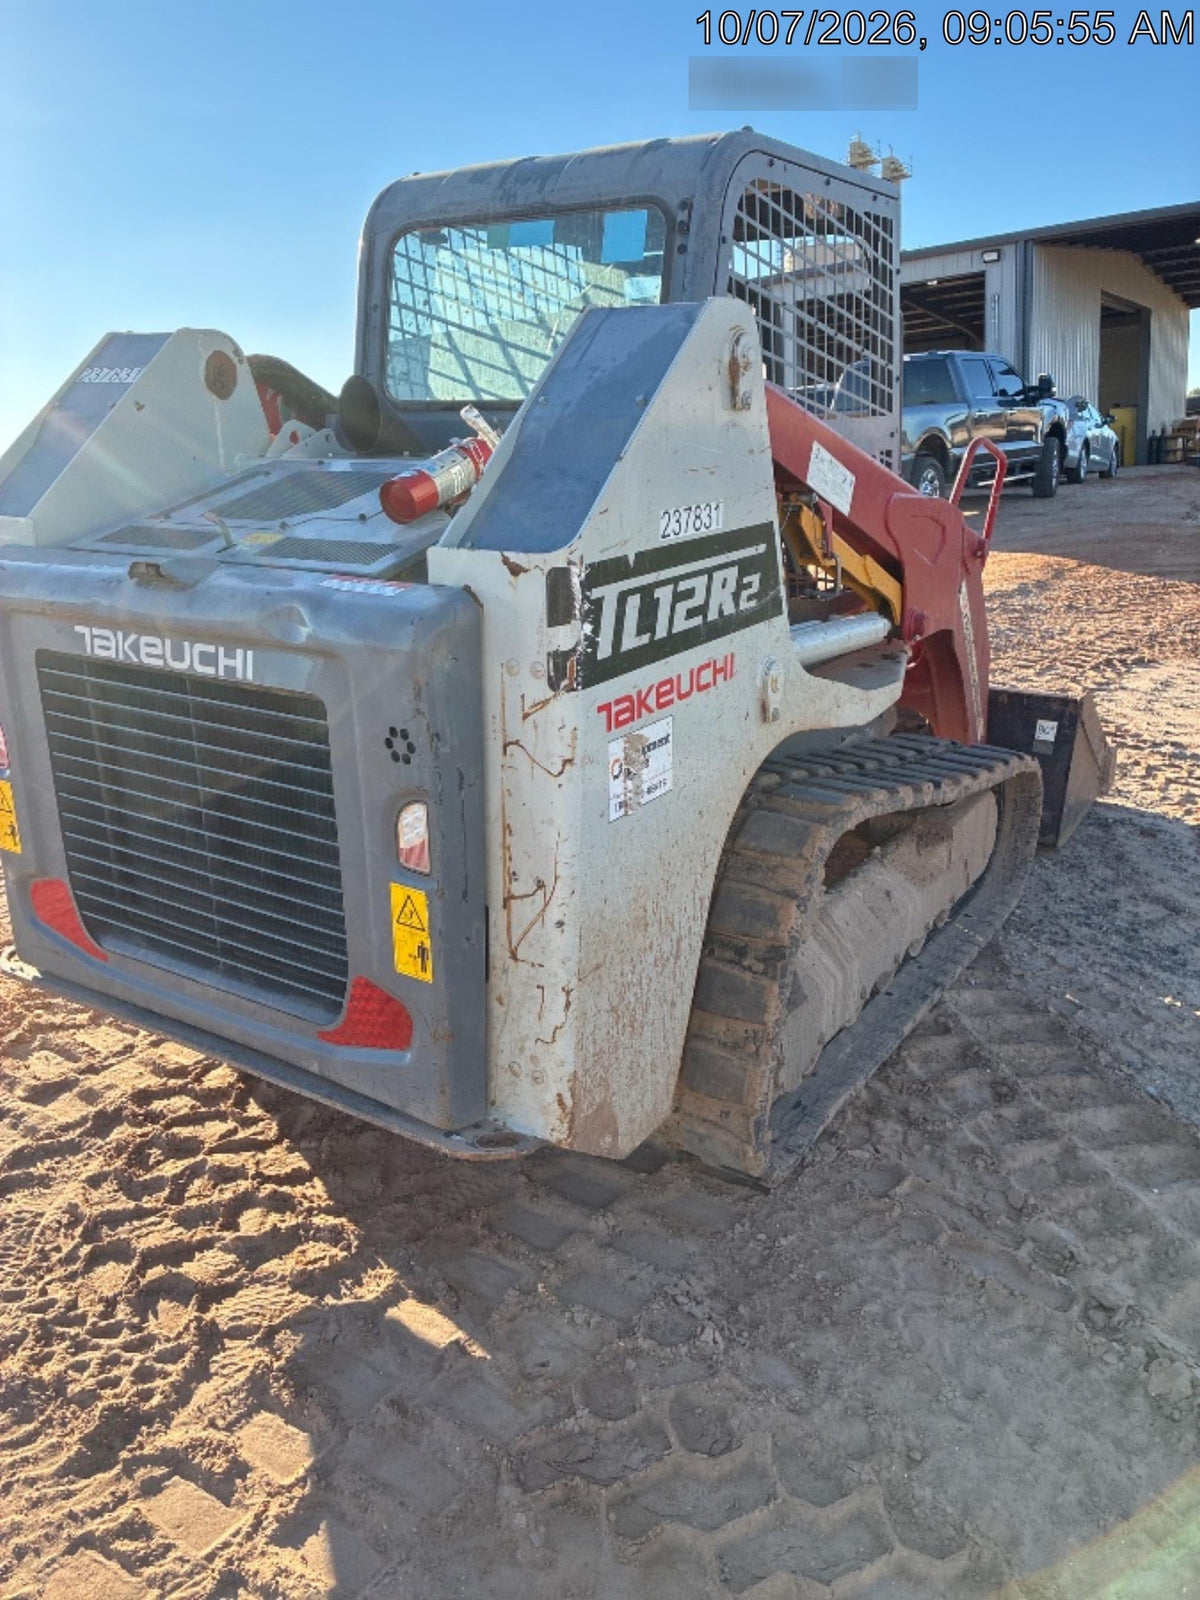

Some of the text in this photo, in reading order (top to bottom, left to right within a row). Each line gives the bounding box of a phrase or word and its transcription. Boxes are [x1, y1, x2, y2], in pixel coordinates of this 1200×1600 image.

[661, 503, 721, 540] 237831
[591, 543, 767, 660] TL12R2
[74, 624, 254, 681] TAKEUCHI
[597, 652, 736, 733] TAKEUCHI
